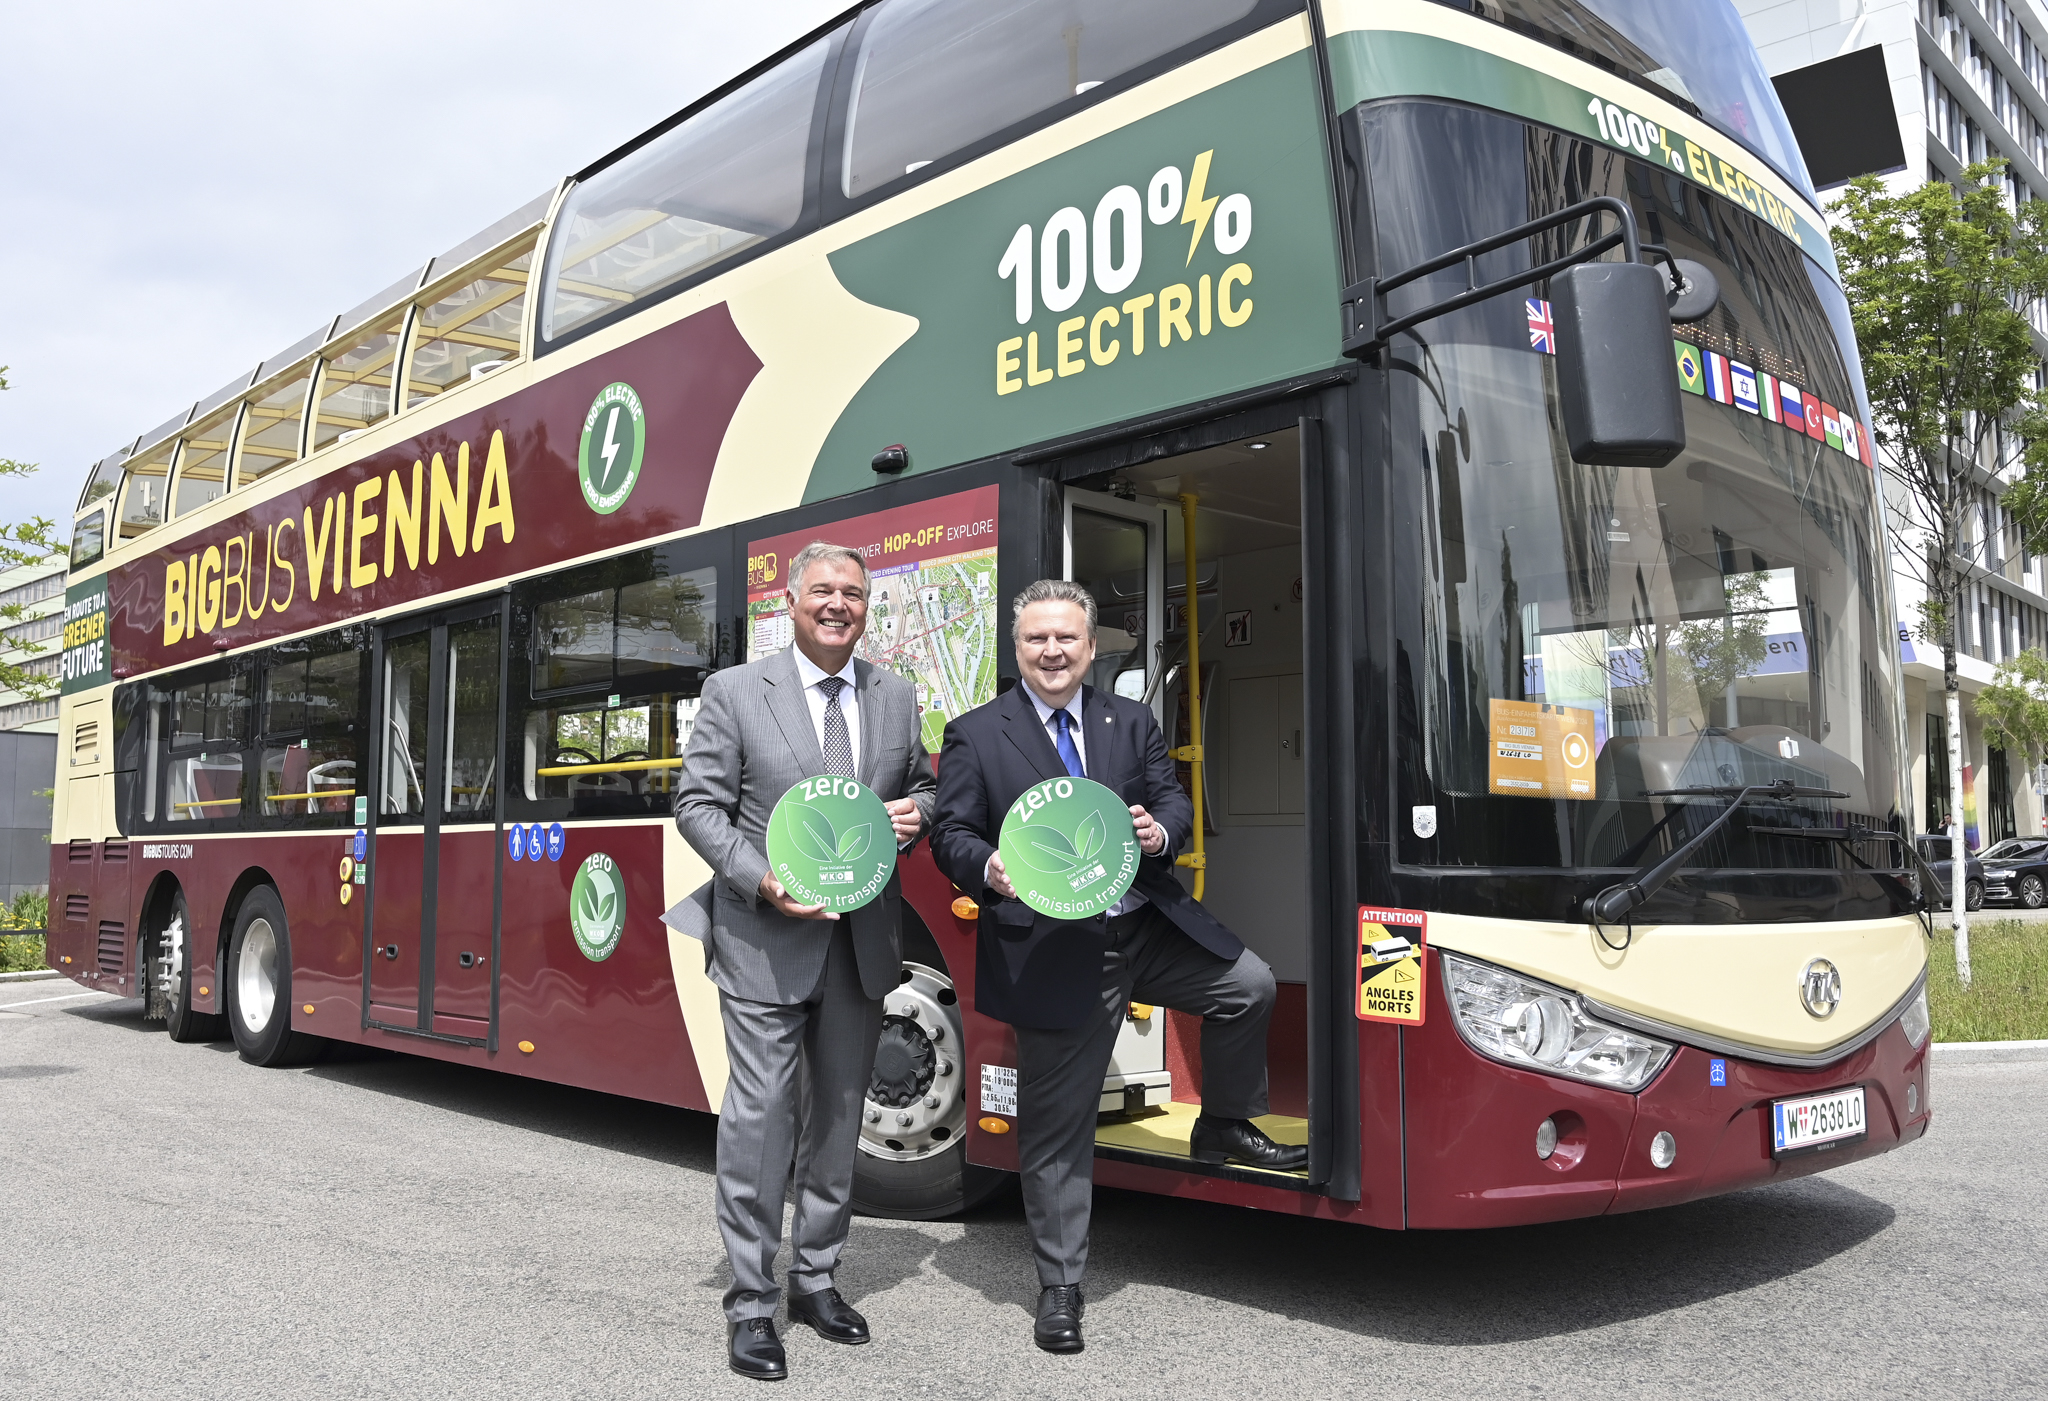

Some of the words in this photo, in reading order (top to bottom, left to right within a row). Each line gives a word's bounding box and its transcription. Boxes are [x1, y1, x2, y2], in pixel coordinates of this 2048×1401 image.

[1587, 98, 1685, 173] 100%
[1685, 140, 1802, 246] ELECTRIC
[998, 149, 1252, 325] 100%
[997, 262, 1254, 396] ELECTRIC
[585, 397, 605, 433] 100%
[605, 385, 642, 422] ELECTRIC
[584, 477, 599, 504] ZERO
[599, 469, 635, 508] EMISSIONS
[303, 429, 515, 601] VIENNA
[884, 525, 944, 554] HOP-OFF
[947, 519, 994, 541] EXPLORE
[748, 555, 764, 572] BIG
[882, 566, 901, 576] EVENING
[902, 564, 914, 572] TOUR
[921, 560, 937, 568] GUIDED
[938, 557, 951, 565] INNER
[962, 551, 984, 560] WALKING
[984, 548, 997, 556] TOUR
[748, 570, 764, 586] BUS
[763, 591, 772, 599] CITY
[772, 589, 785, 597] ROUTE
[64, 603, 72, 623] EN
[72, 596, 92, 620] ROUTE
[93, 592, 100, 611] TO
[100, 590, 106, 608] A
[63, 611, 105, 650] GREENER
[61, 639, 104, 682] FUTURE
[1497, 708, 1560, 721] BUS-EINFAHRTSKARTE
[1561, 716, 1574, 724] WIEN
[1510, 726, 1535, 736] 2378
[799, 777, 860, 802] zero
[1012, 780, 1073, 823] zero
[585, 853, 612, 873] zero
[820, 872, 844, 881] WKO
[1028, 889, 1095, 913] emission
[1095, 840, 1134, 904] transport
[779, 862, 831, 906] emission
[836, 862, 889, 907] transport
[1070, 871, 1095, 889] WKO
[1362, 910, 1423, 925] ATTENTION
[573, 920, 595, 957] emission
[596, 924, 621, 957] transport
[1366, 986, 1415, 1001] ANGLES
[1368, 999, 1412, 1014] MORTS
[1778, 1131, 1783, 1141] A
[1787, 1108, 1798, 1139] W
